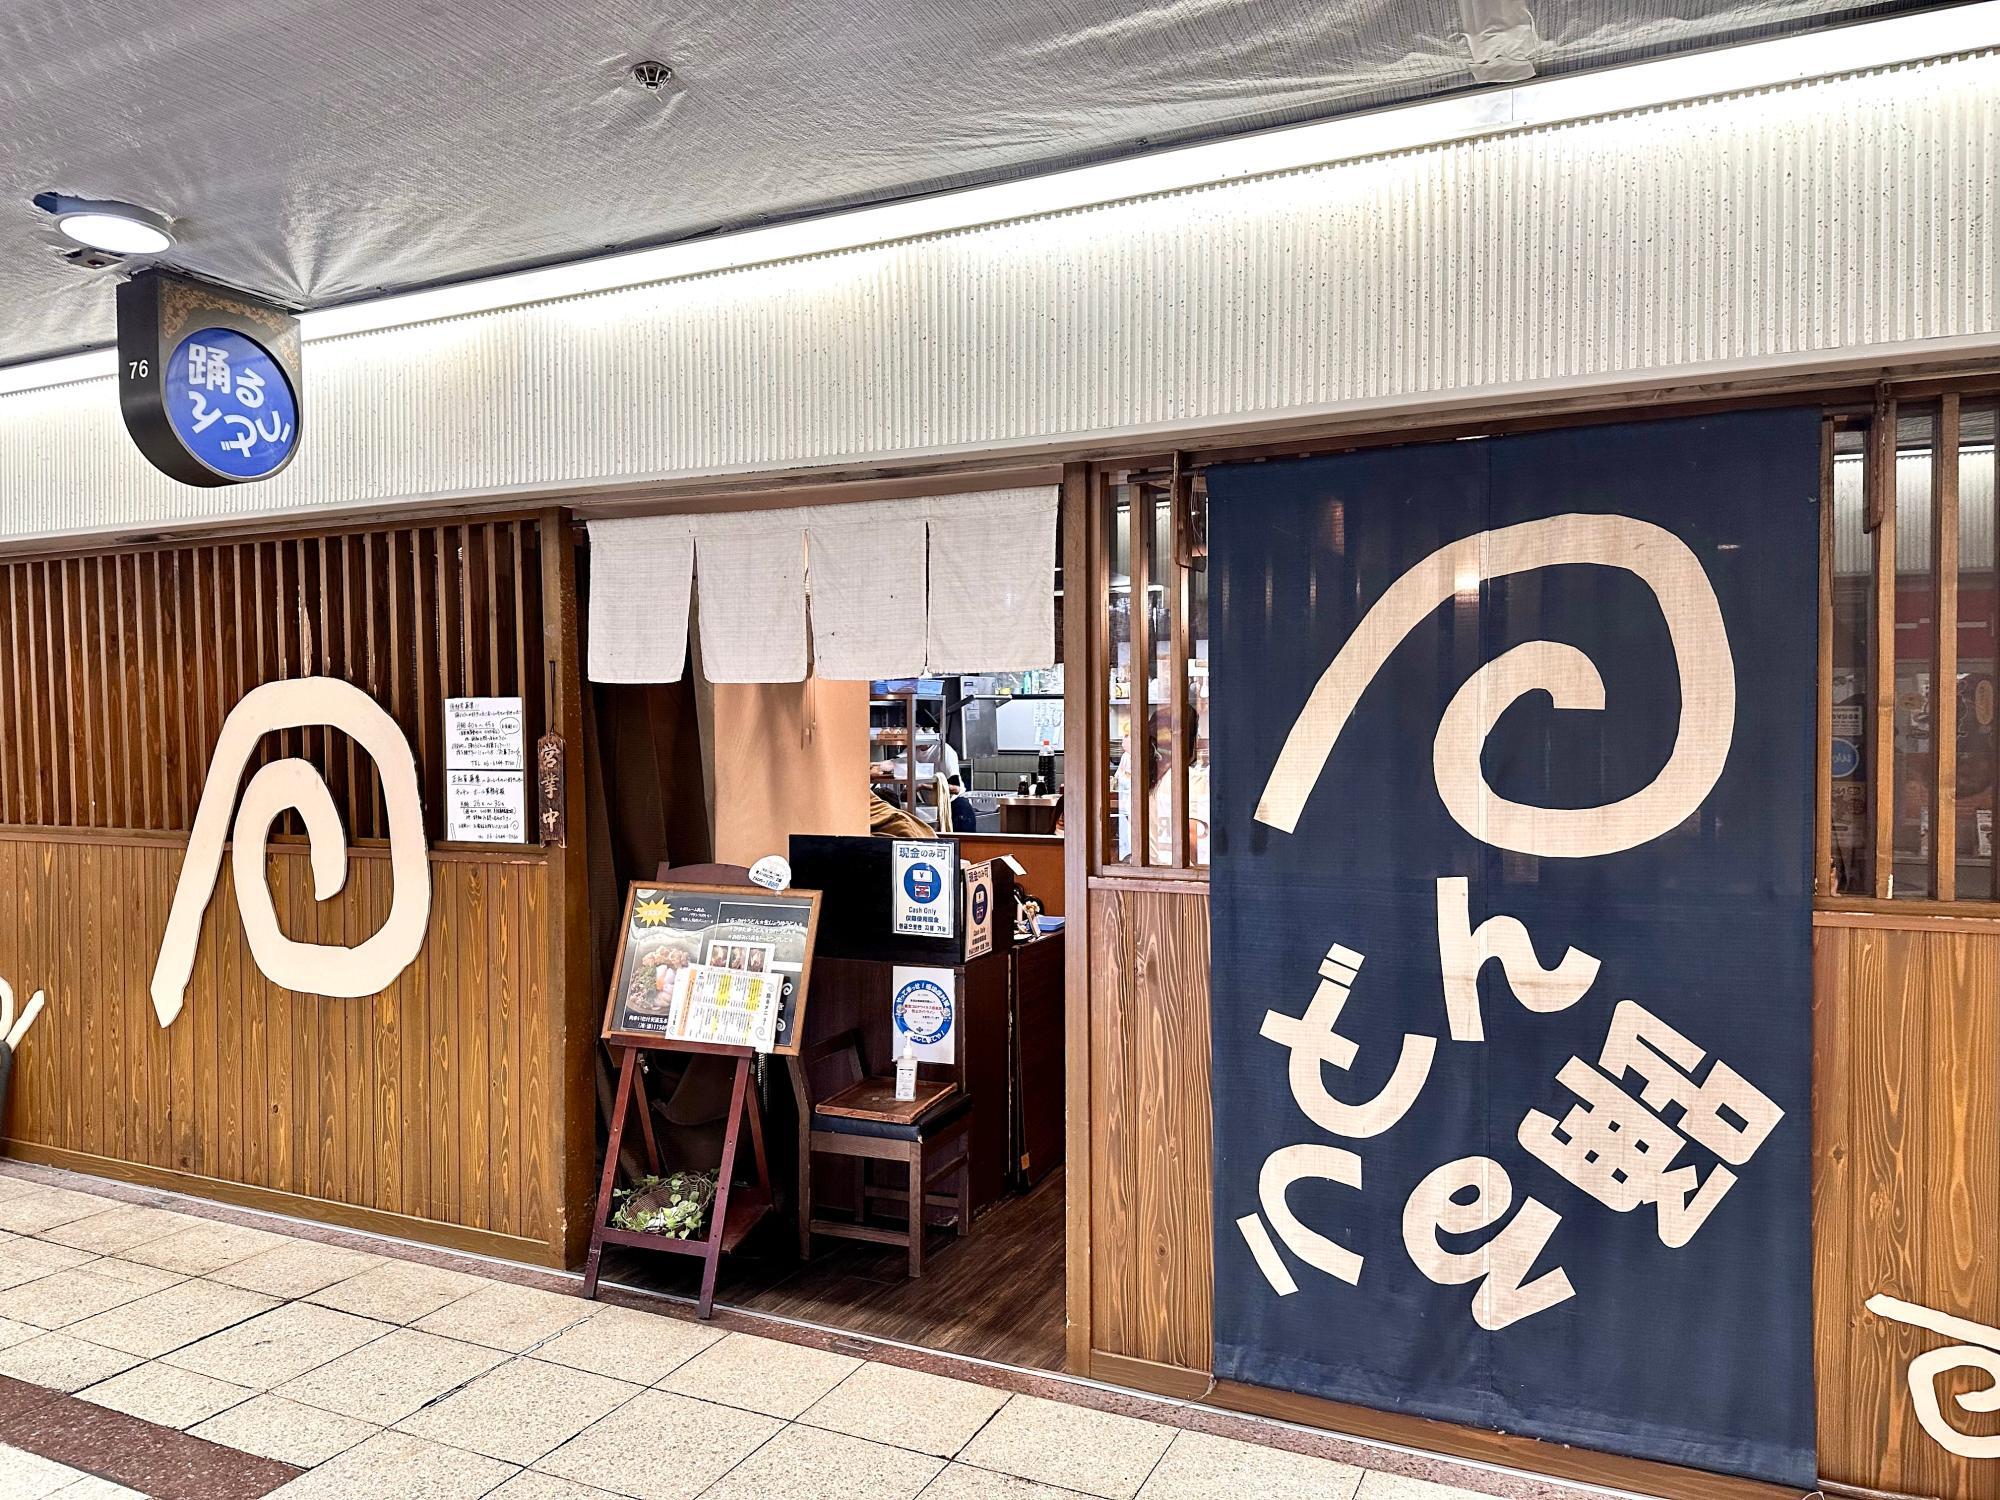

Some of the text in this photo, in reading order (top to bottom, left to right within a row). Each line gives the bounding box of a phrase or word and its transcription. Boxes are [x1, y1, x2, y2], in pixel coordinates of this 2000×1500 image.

[129, 360, 149, 380] 76
[541, 742, 560, 833] 営業中
[899, 847, 947, 860] 現金のみ可
[923, 907, 937, 915] Only
